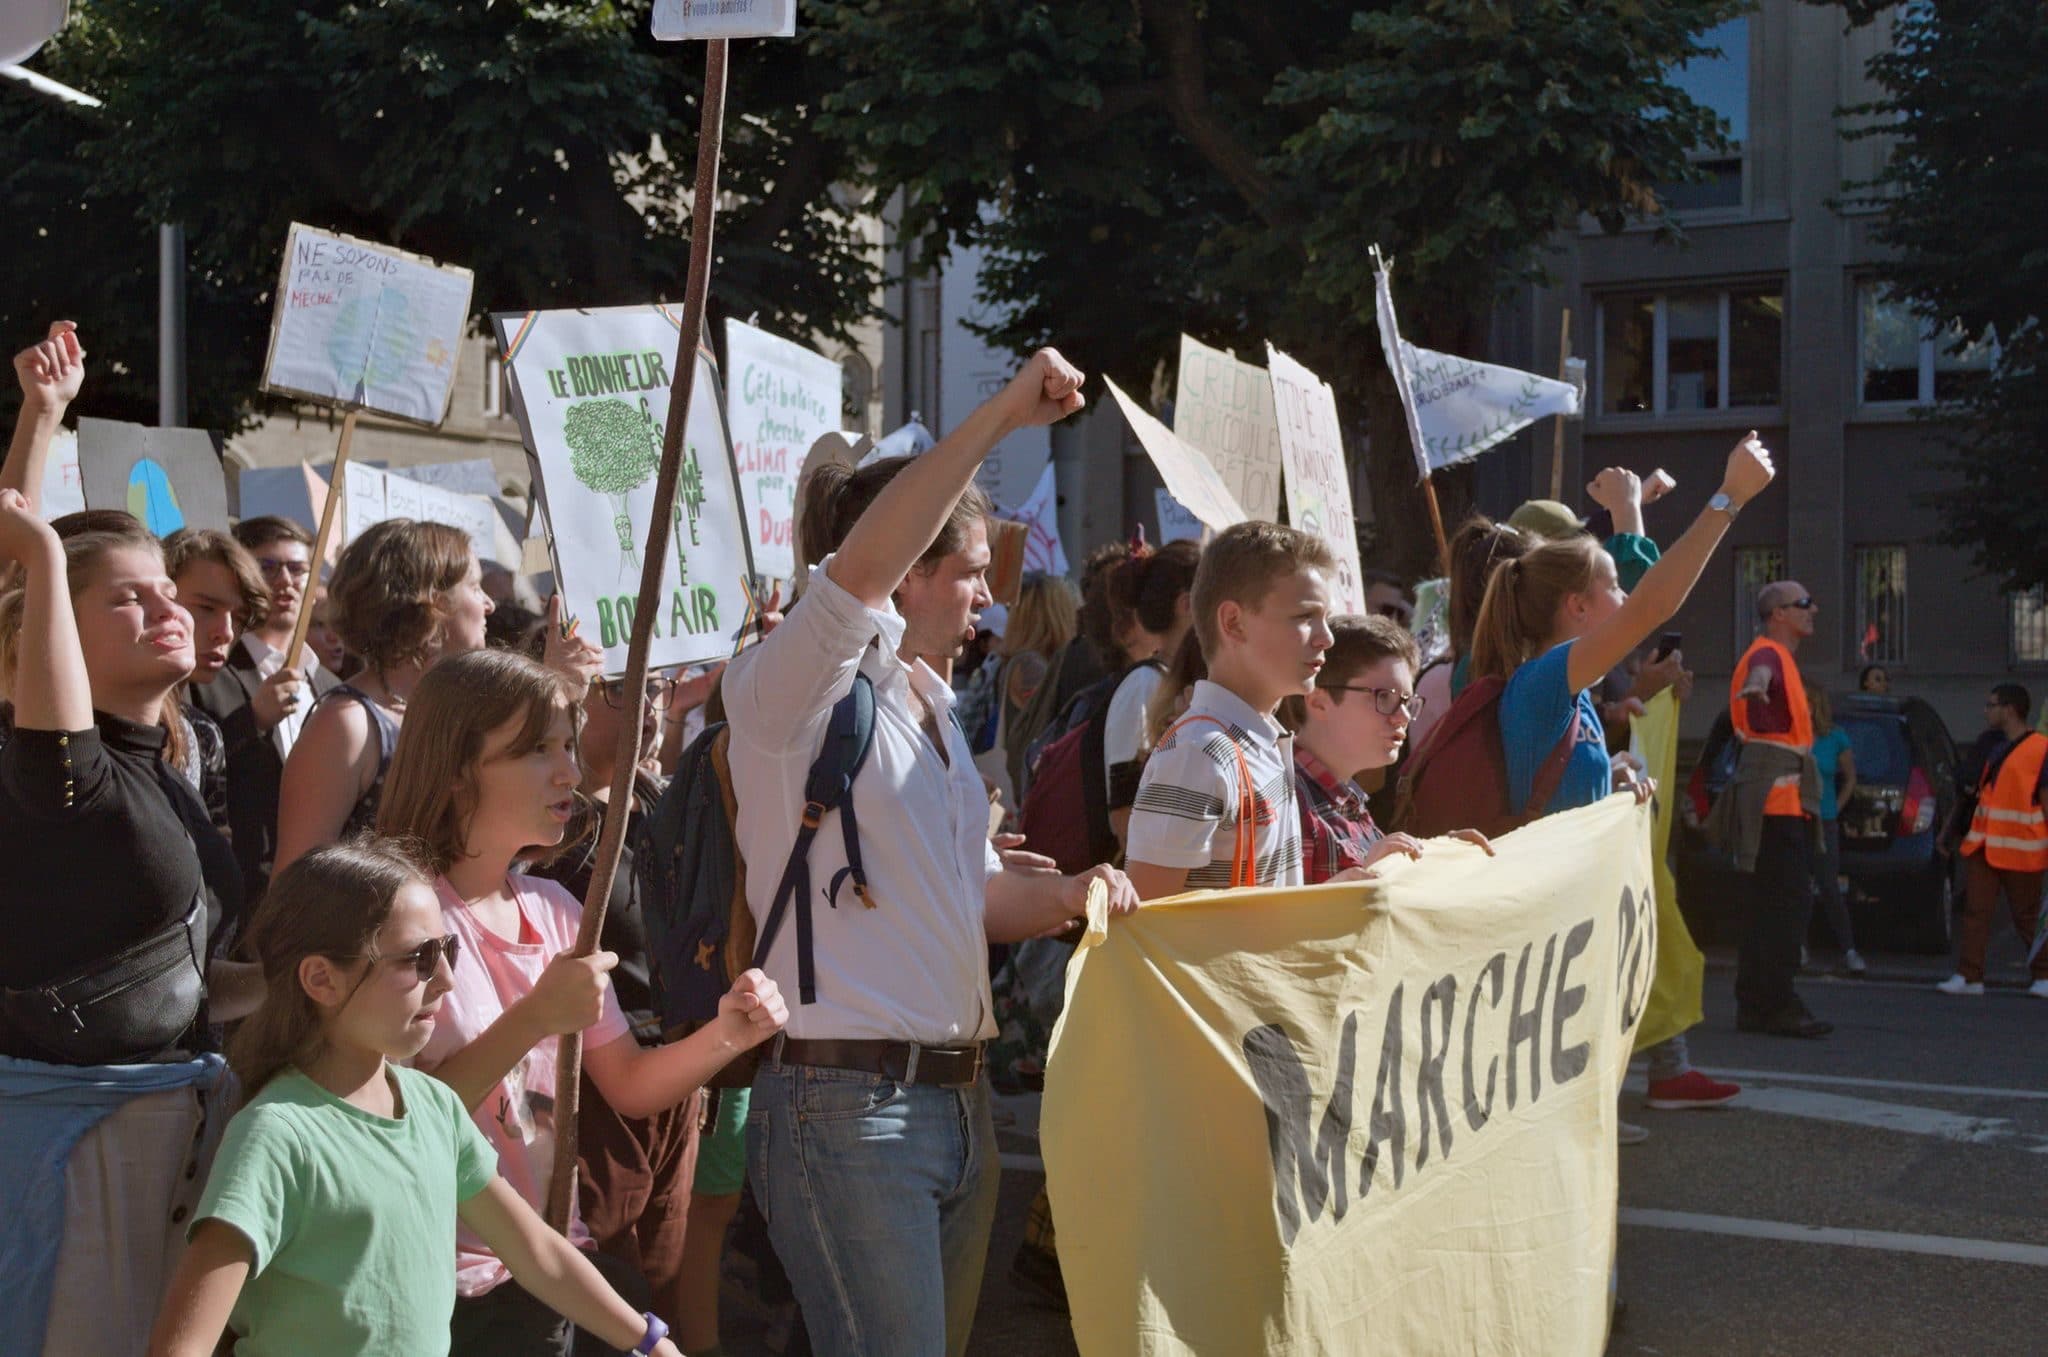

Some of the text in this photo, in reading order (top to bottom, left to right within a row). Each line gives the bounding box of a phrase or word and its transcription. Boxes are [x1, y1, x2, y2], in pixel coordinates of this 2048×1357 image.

[298, 242, 400, 274] NE SOYONS
[298, 269, 354, 285] PAS DE
[548, 351, 671, 398] LE BONHEUR
[597, 585, 719, 648] BO AIR
[1243, 918, 1594, 1249] MARCHE
